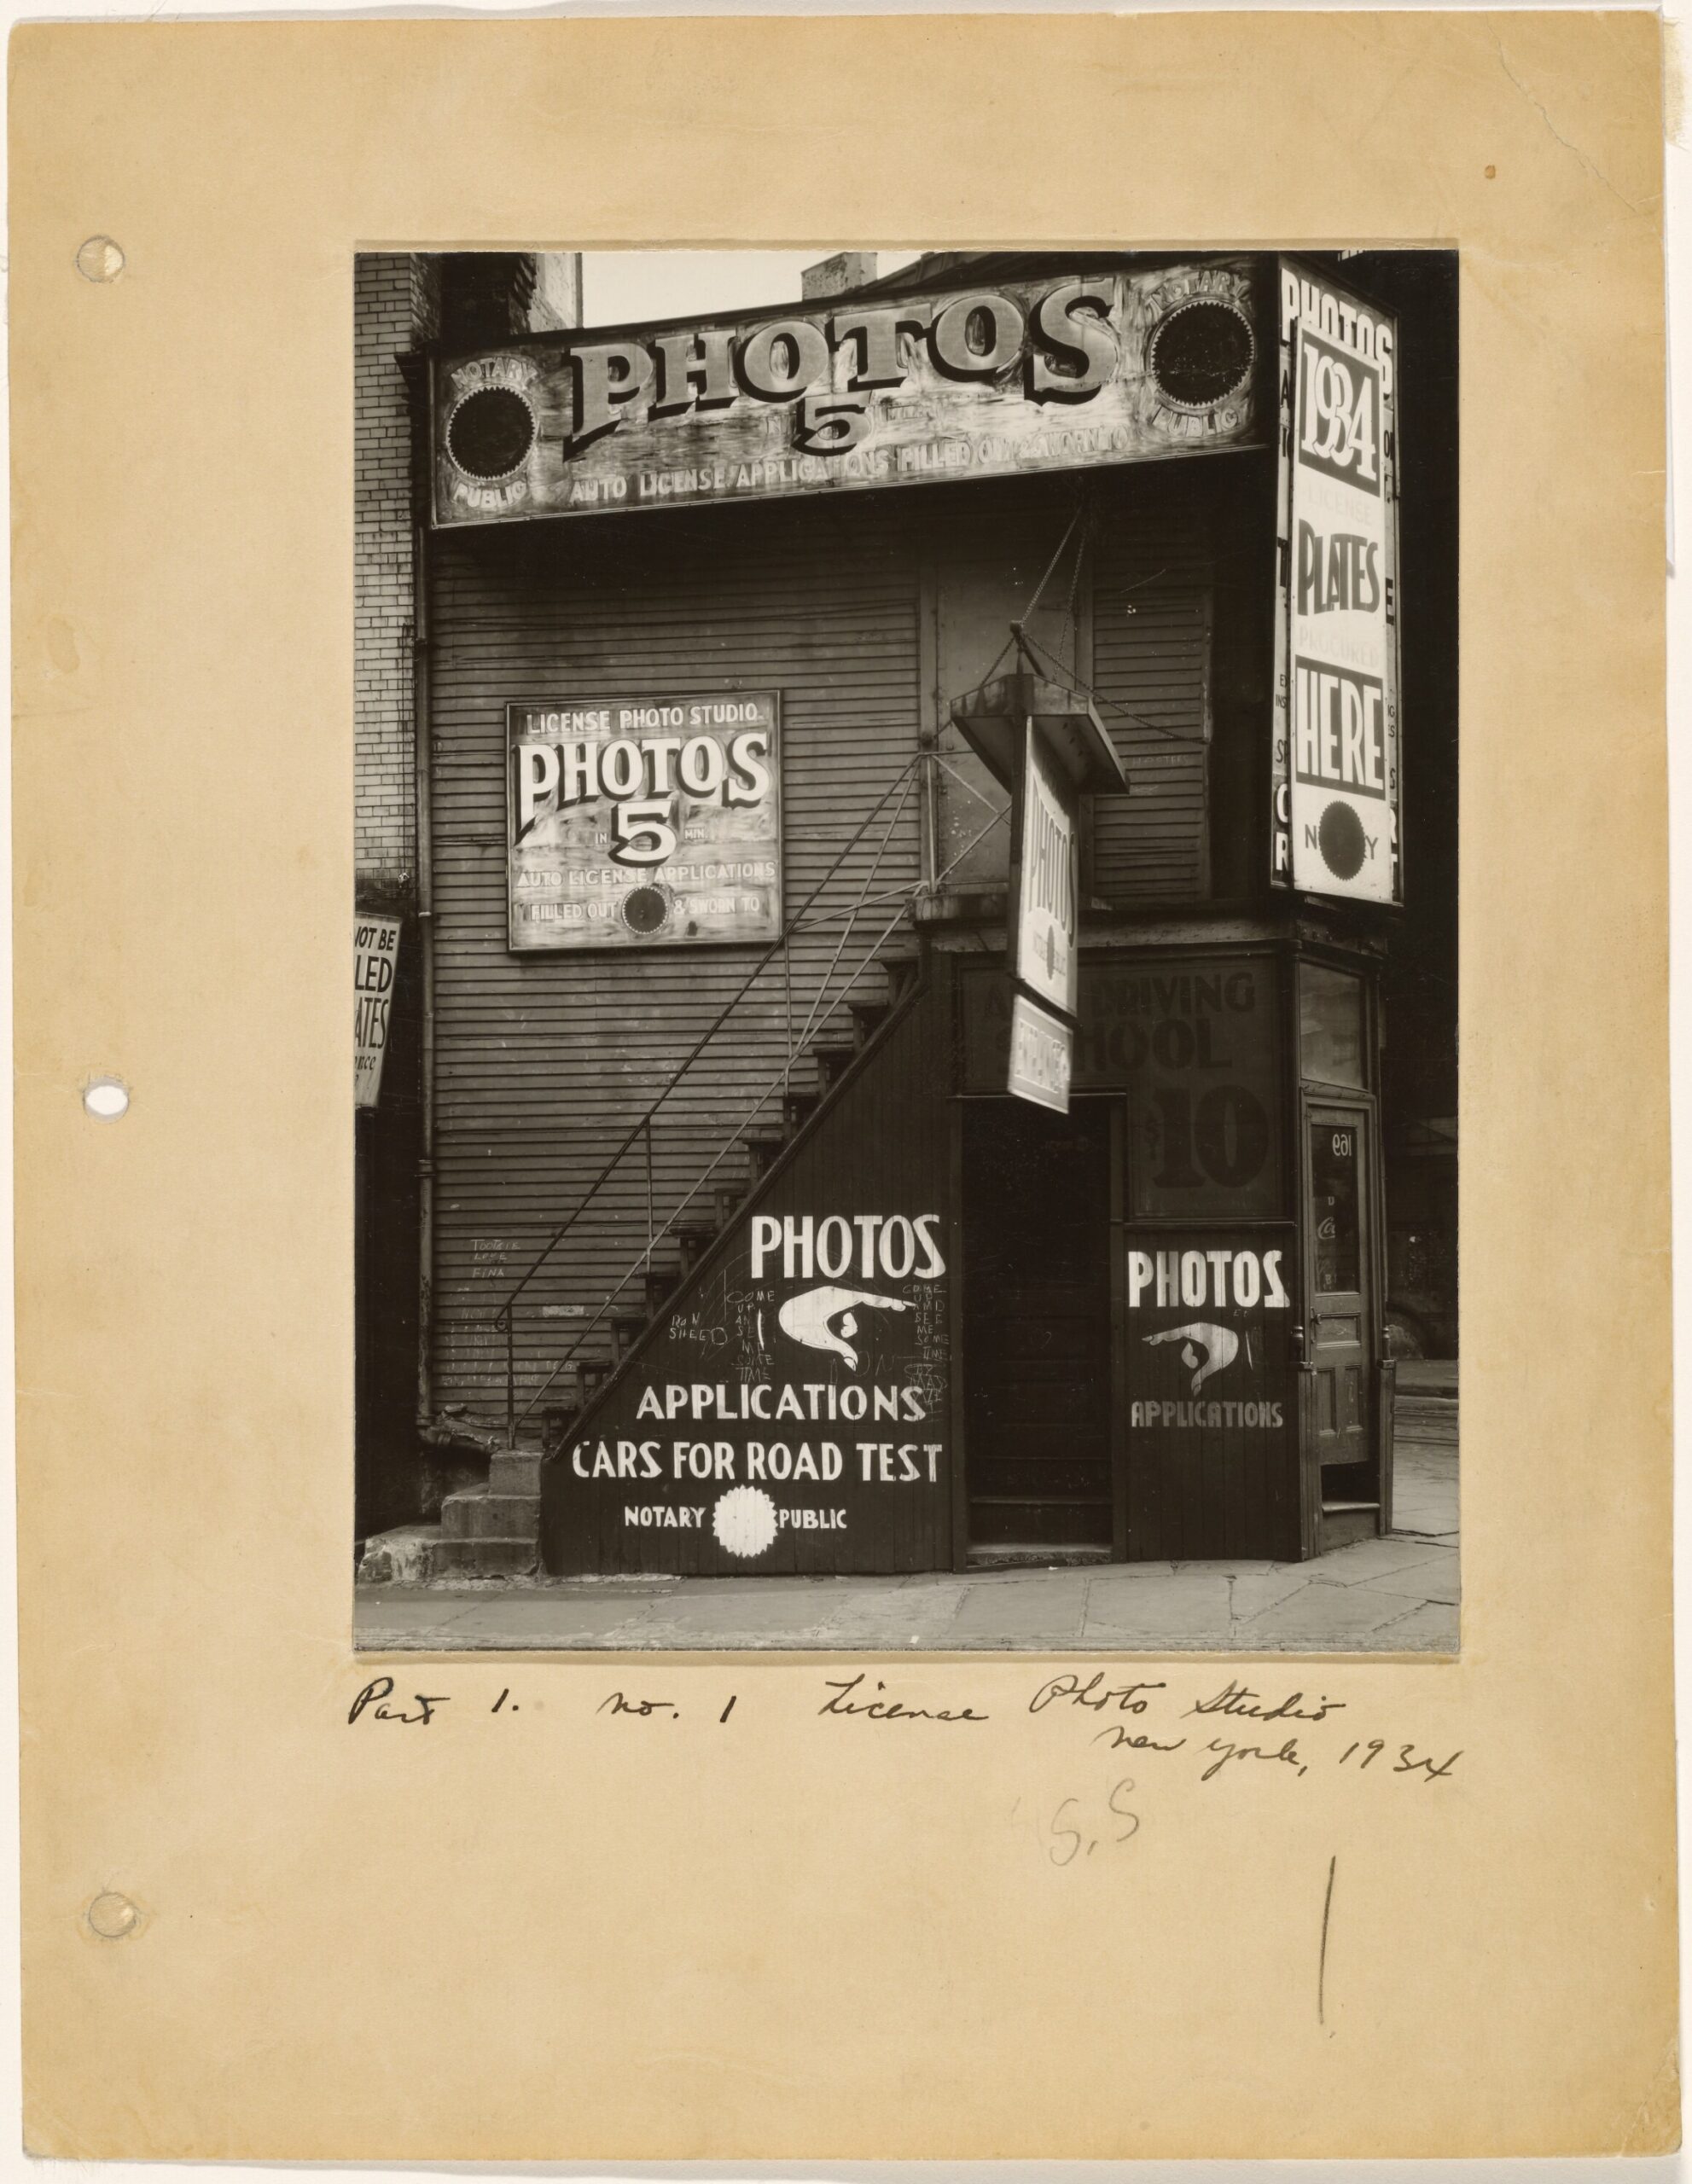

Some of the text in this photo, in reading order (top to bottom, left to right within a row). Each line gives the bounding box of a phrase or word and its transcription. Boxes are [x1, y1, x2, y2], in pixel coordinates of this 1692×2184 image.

[1148, 270, 1252, 311] NOTARY
[1281, 268, 1394, 399] PHOTOS
[451, 356, 538, 391] NOTARY
[564, 276, 1119, 462] PHOTOS
[794, 390, 872, 457] 5
[1153, 404, 1241, 438] PUBLIC
[1301, 343, 1377, 482] 1934
[570, 474, 627, 503] AUTO
[640, 467, 726, 497] LICENSE
[735, 444, 891, 489] APPLICATIONS
[897, 439, 972, 472] FILLED
[451, 482, 528, 510] PUBLIC
[1298, 519, 1381, 616] PLATES
[526, 710, 611, 735] LICENSE
[619, 706, 683, 730] PHOTO
[1297, 666, 1384, 791] HERE
[512, 731, 770, 848] PHOTOS
[595, 831, 608, 845] IN
[608, 799, 677, 868] 5
[517, 861, 777, 889] AUTO LICENSE APPLICATIONS
[1027, 773, 1076, 950] PHOTOS
[531, 902, 583, 921] FILLED
[587, 901, 617, 919] OUT
[689, 897, 736, 915] SWORN
[741, 895, 761, 913] TO
[377, 927, 398, 951] BE
[1091, 972, 1256, 1018] DRIVING
[751, 1214, 946, 1279] PHOTOS
[1128, 1250, 1291, 1308] PHOTOS
[636, 1384, 927, 1422] APPLICATIONS
[1131, 1400, 1284, 1428] APPLICATIONS
[573, 1441, 944, 1484] CARS FOR ROAD TEST
[624, 1505, 848, 1530] NOTARY PUBLIC
[347, 1676, 451, 1725] Part
[818, 1673, 990, 1722] License
[1029, 1671, 1167, 1715] Photo
[1180, 1679, 1346, 1722] Studio
[1339, 1739, 1465, 1784] 1934
